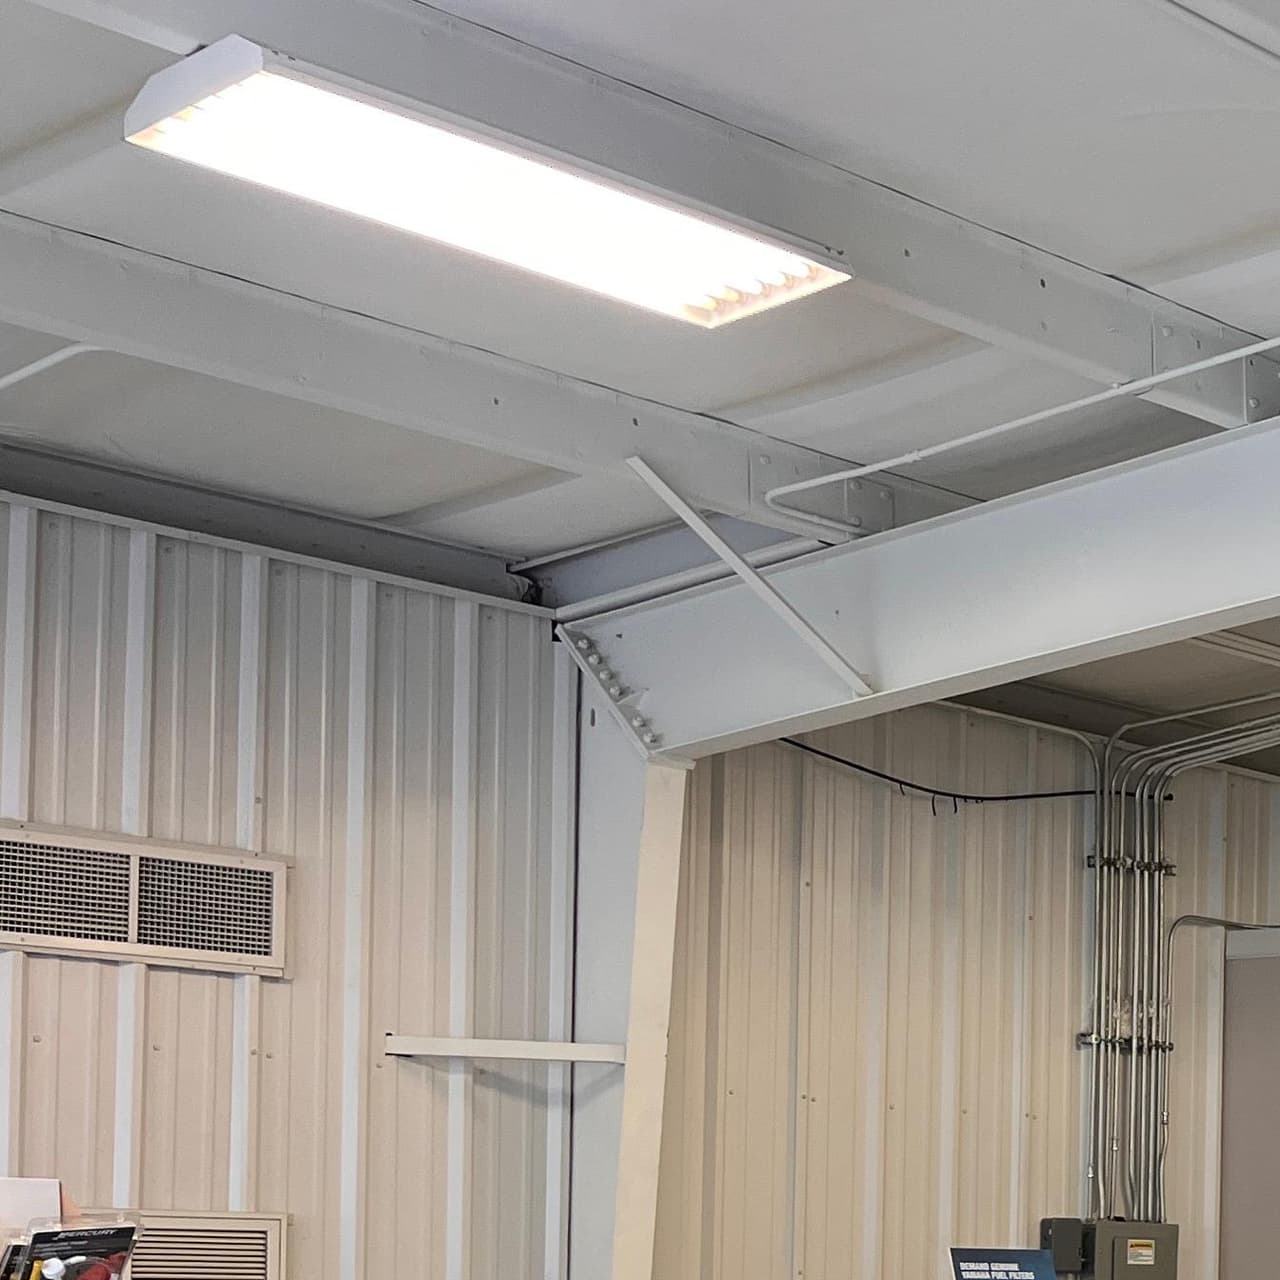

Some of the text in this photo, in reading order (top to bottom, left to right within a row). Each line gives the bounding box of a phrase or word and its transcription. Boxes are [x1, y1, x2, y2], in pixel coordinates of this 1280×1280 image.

[52, 1230, 117, 1240] MERCURY
[991, 1272, 1009, 1280] FUEL
[1009, 1272, 1035, 1280] FILTERS
